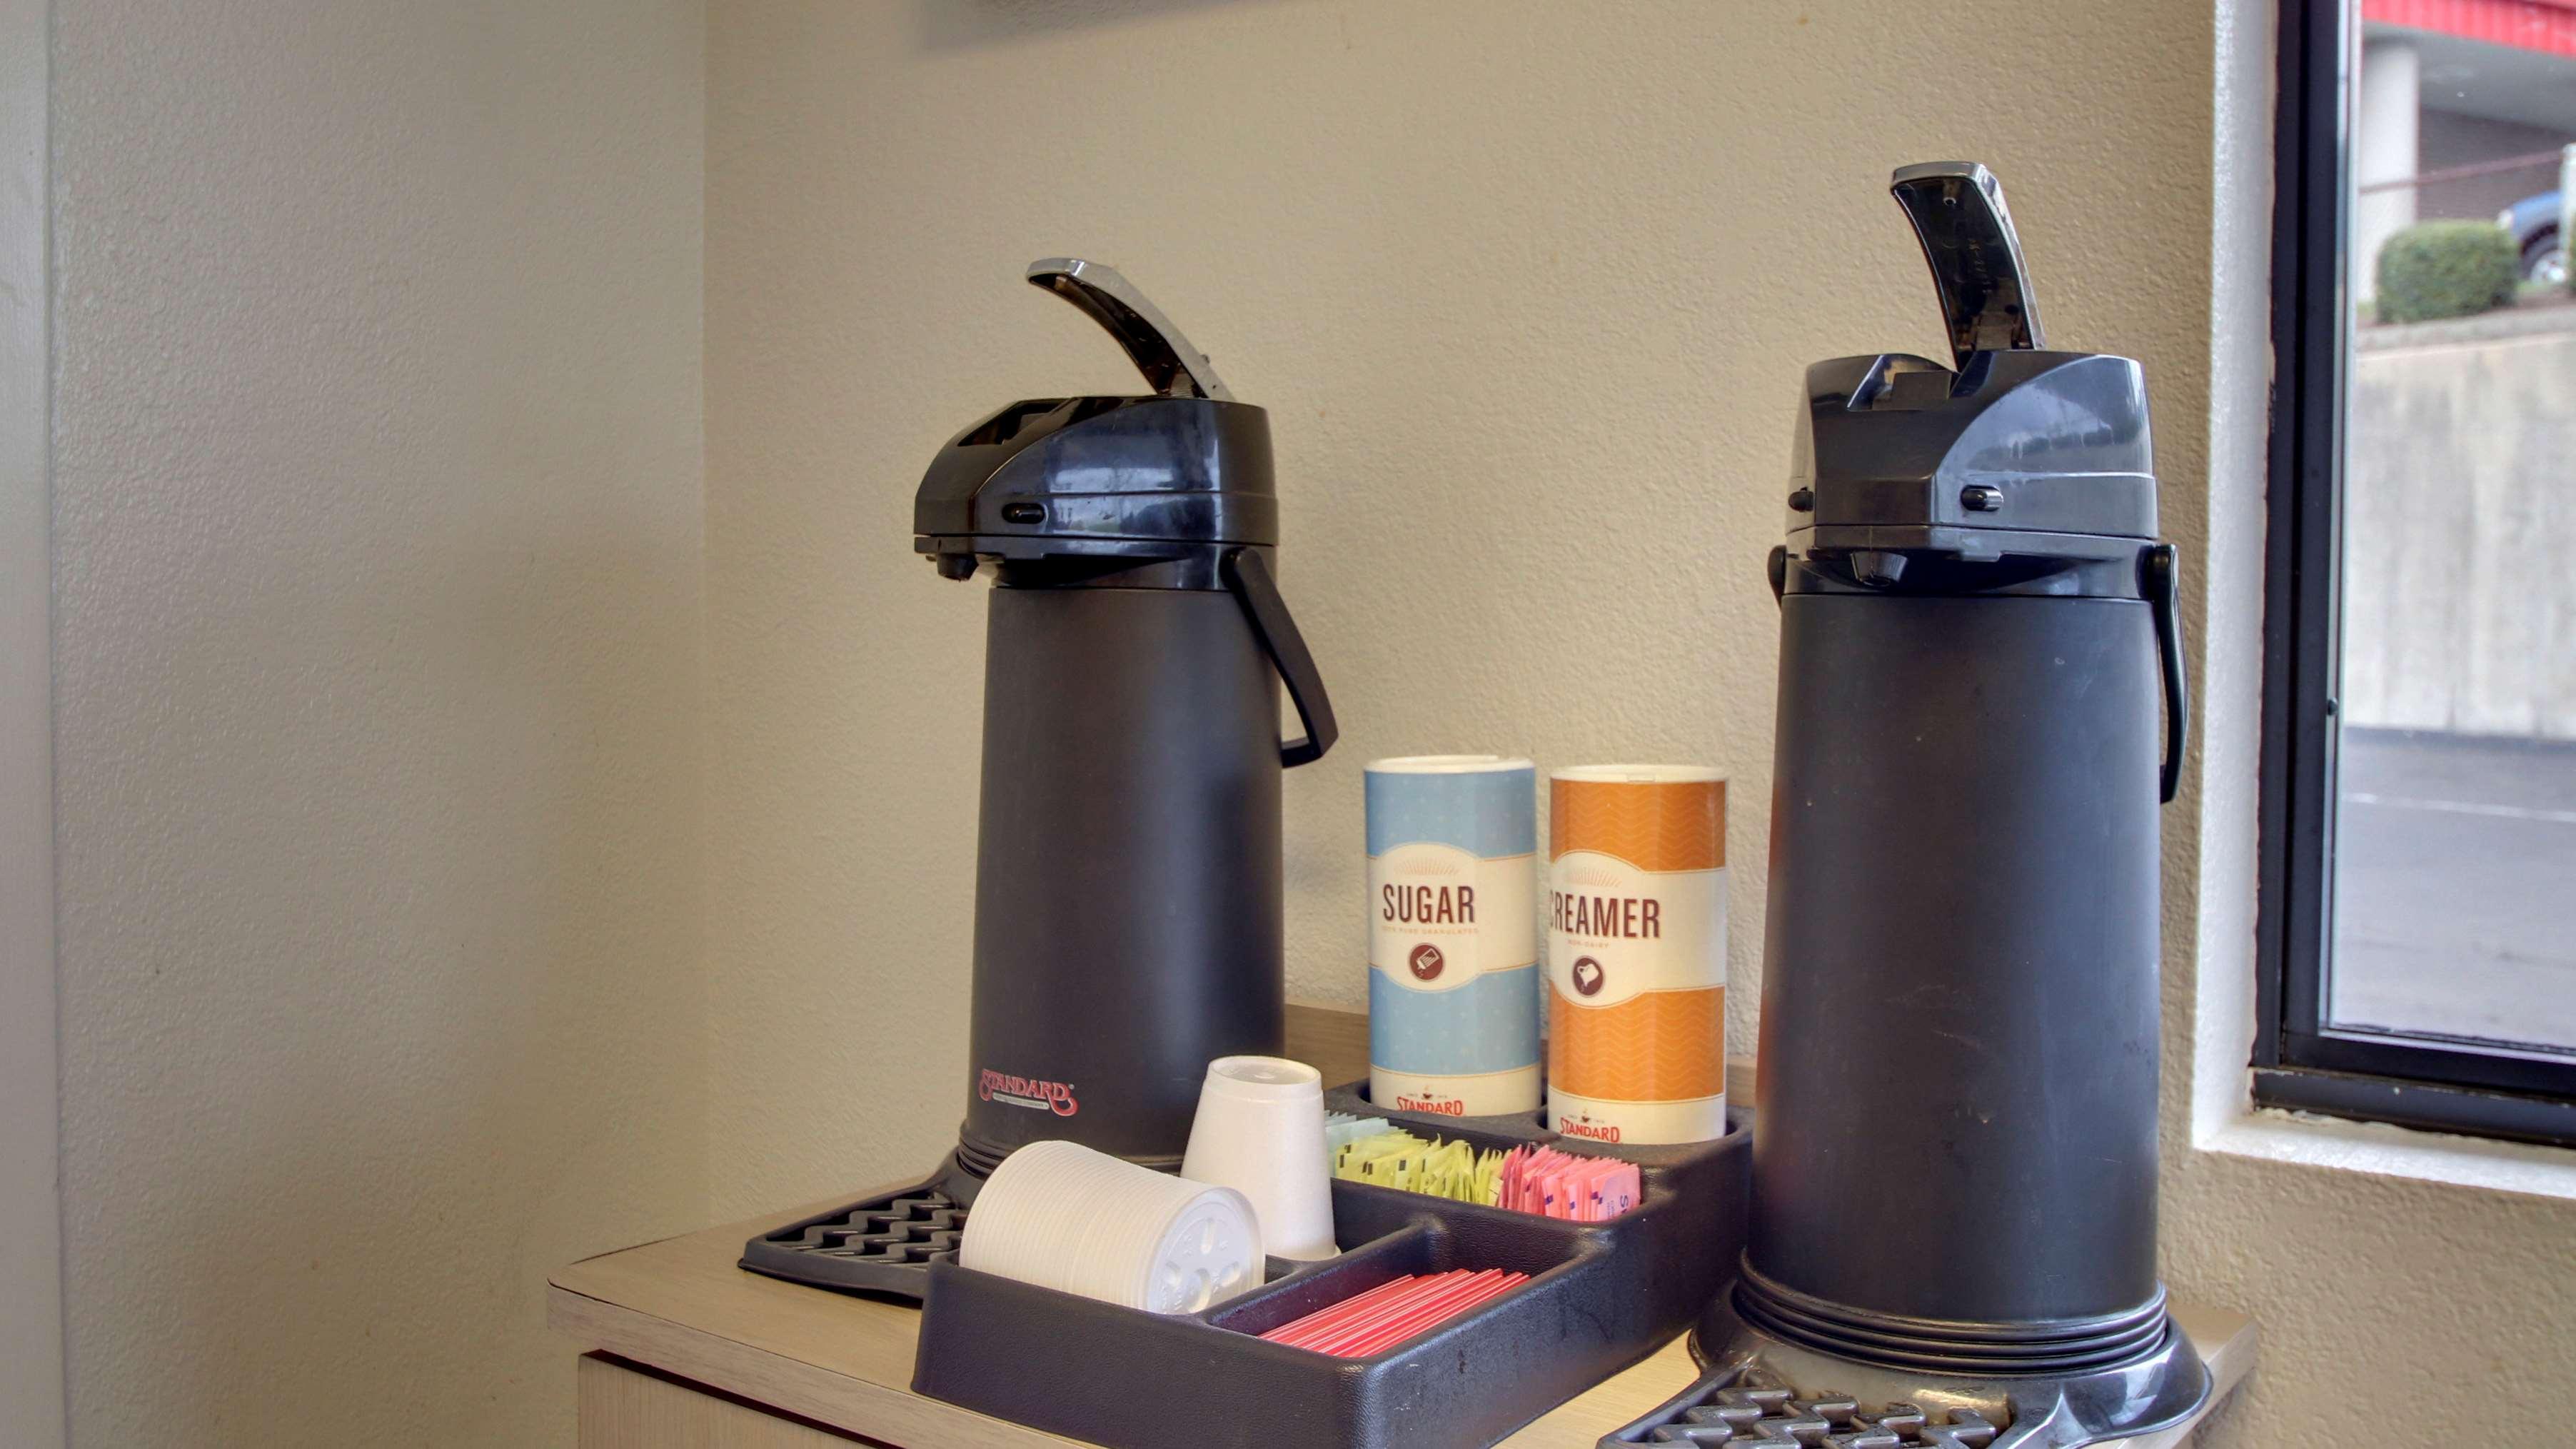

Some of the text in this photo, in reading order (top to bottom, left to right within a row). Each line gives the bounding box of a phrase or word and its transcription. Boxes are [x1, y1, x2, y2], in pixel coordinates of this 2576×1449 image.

[1383, 883, 1475, 924] SUGAR
[1549, 889, 1660, 938] CREAMER
[979, 1068, 1078, 1116] STANDARD
[1397, 1095, 1463, 1115] STANDARD
[1559, 1116, 1620, 1143] STANDARD
